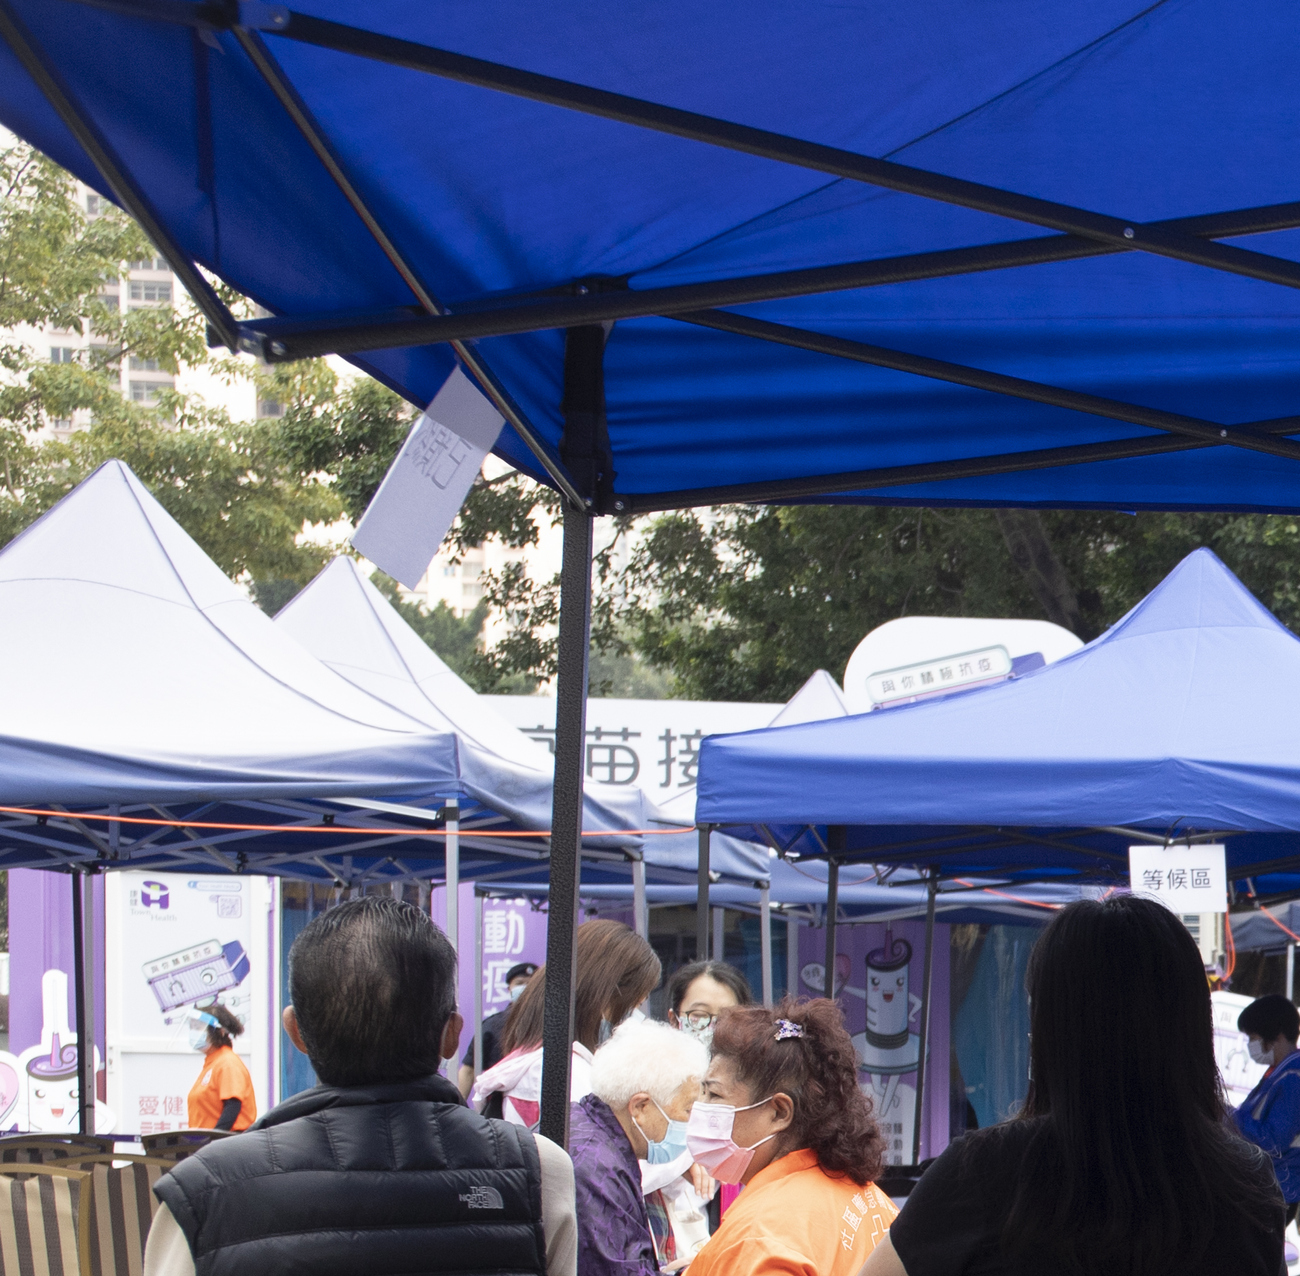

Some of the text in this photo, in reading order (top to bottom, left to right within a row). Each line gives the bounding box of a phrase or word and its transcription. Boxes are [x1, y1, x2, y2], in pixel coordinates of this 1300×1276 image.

[1143, 868, 1211, 890] 等候區
[470, 1186, 487, 1194] THE
